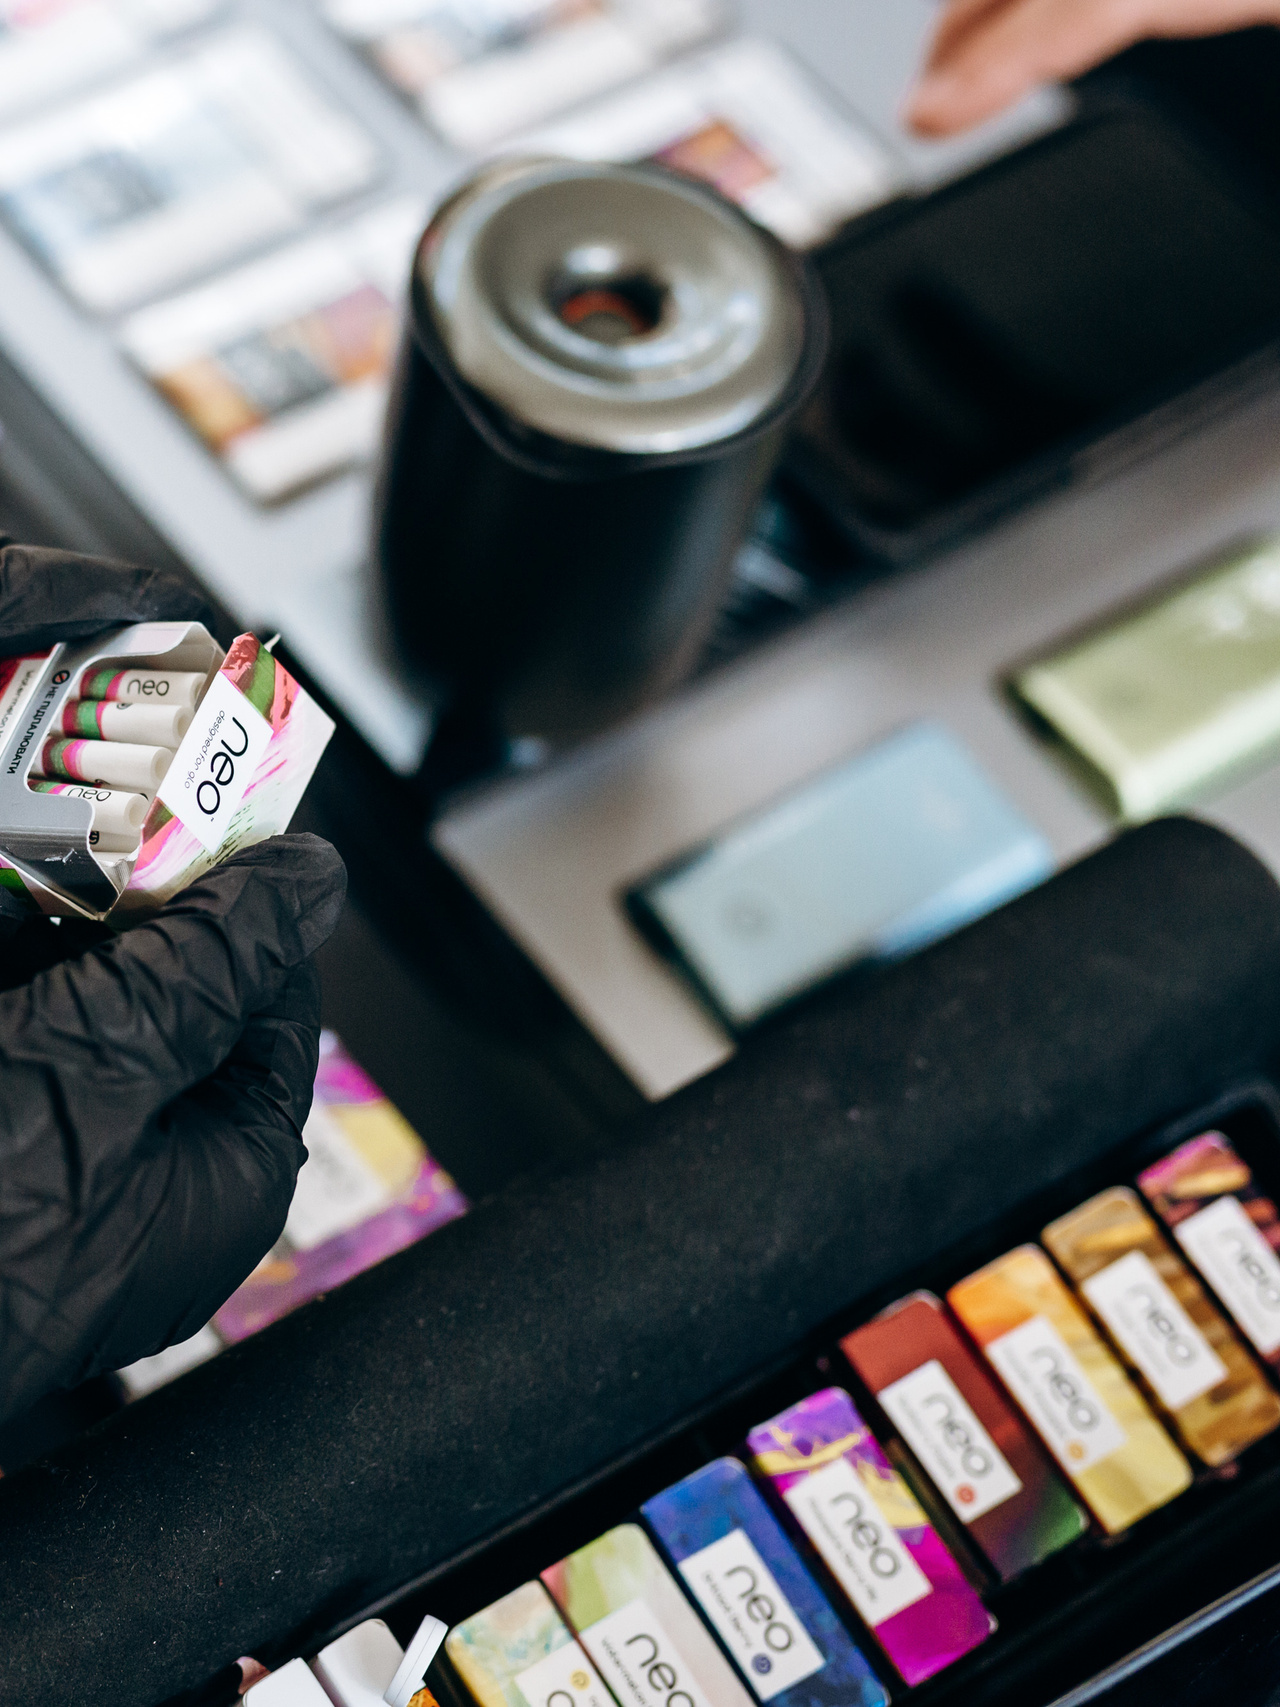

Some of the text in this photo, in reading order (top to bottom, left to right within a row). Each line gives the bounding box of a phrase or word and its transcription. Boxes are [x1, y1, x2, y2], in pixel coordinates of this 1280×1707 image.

[6, 686, 59, 774] НЕ ПІДПАЛЮВАТИ
[127, 679, 170, 696] neo
[184, 710, 226, 789] designed for glo
[196, 716, 249, 815] neo
[67, 787, 112, 802] neo
[1029, 1346, 1101, 1432] neo
[921, 1393, 994, 1478] neo
[831, 1492, 901, 1579] neo
[725, 1565, 793, 1653] neo
[624, 1634, 695, 1707] neo
